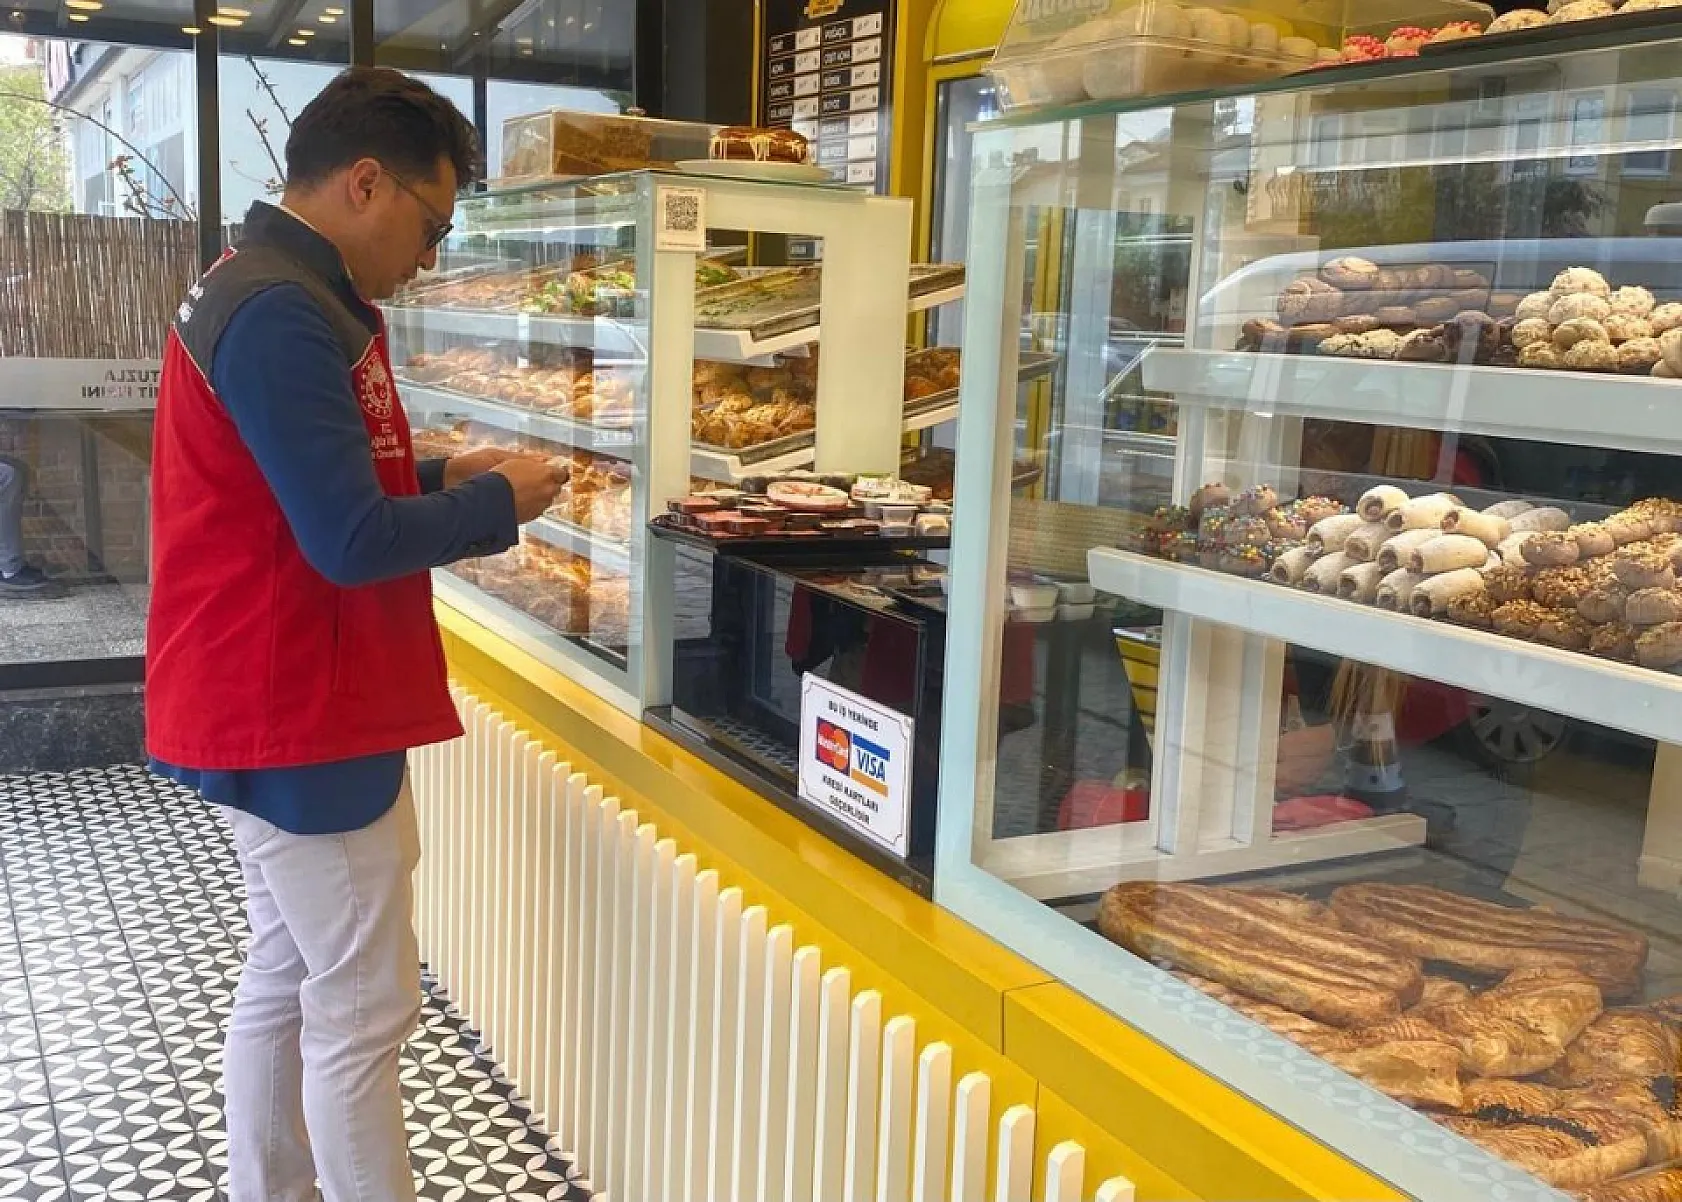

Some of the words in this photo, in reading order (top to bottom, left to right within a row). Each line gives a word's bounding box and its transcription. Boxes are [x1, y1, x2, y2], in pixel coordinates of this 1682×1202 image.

[828, 700, 838, 713] BU
[848, 707, 879, 732] YERİNDE
[856, 748, 886, 782] VISA
[844, 785, 879, 813] KARTLARI
